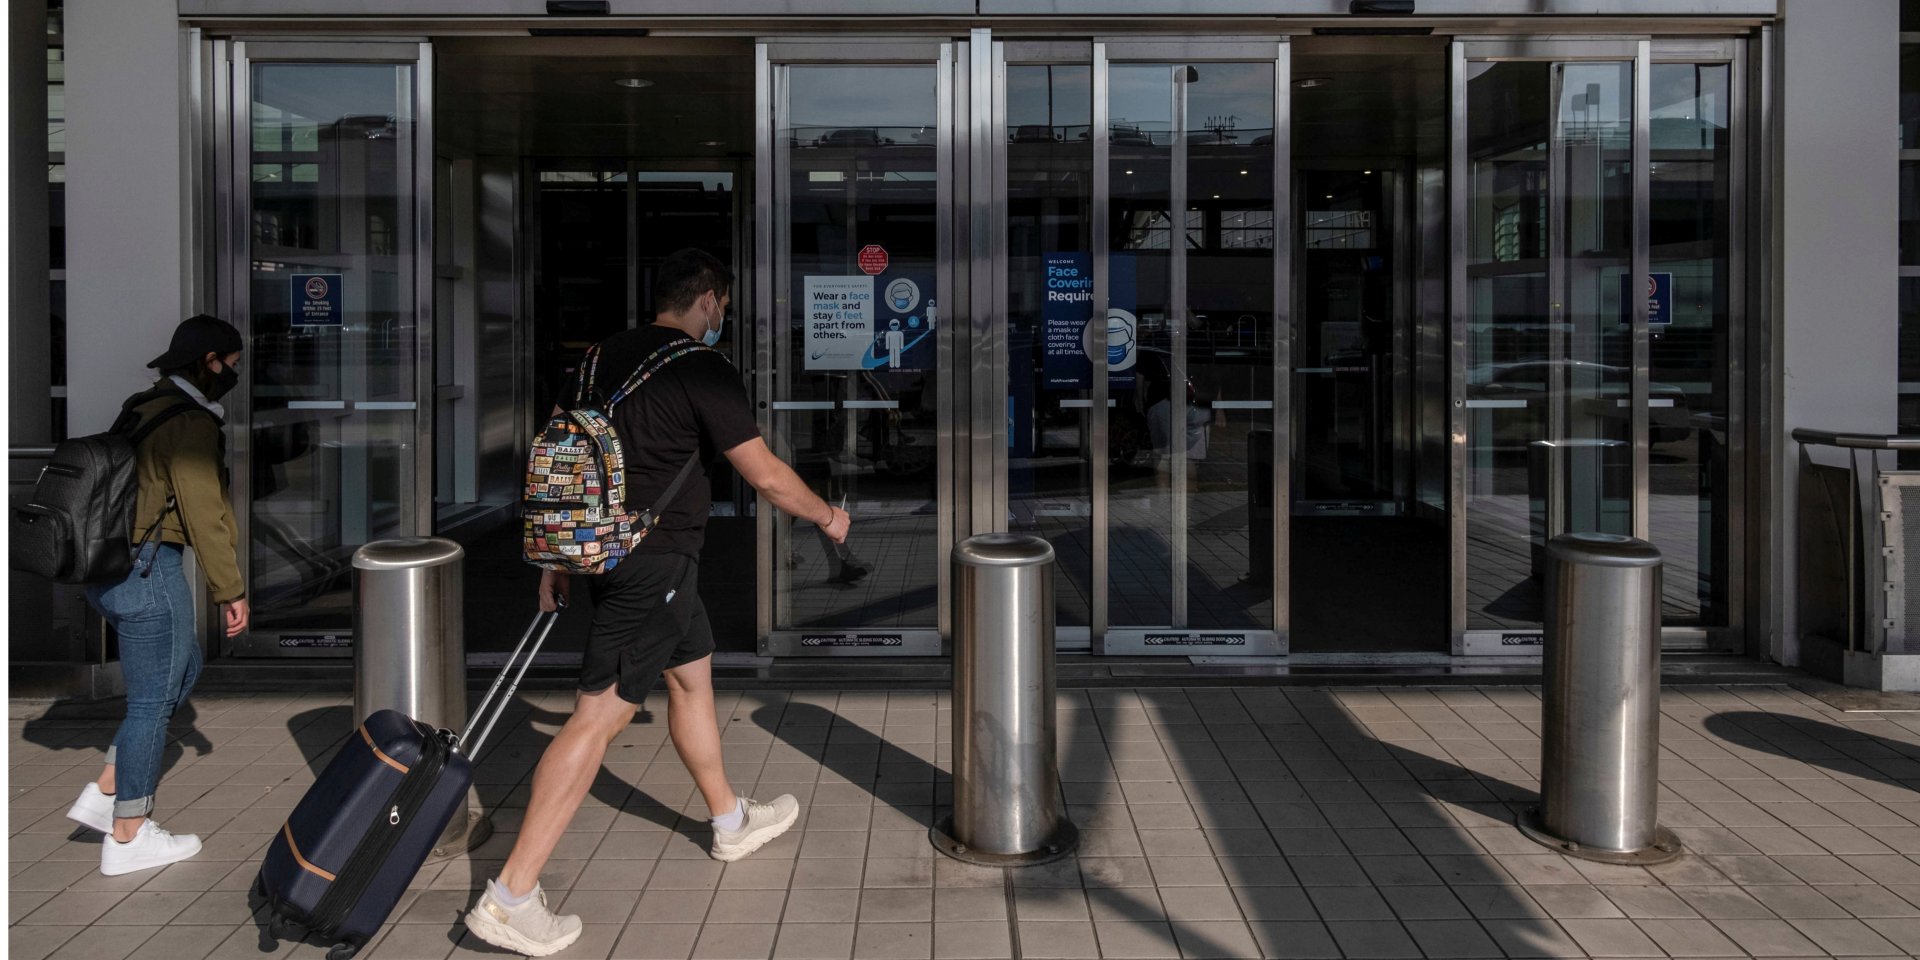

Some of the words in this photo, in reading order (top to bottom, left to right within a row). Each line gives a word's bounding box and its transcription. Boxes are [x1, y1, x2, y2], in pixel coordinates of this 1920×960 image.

[1048, 266, 1078, 277] Face
[1048, 277, 1094, 288] Coverin
[813, 292, 839, 300] Wear
[849, 292, 870, 300] face
[813, 302, 839, 310] mask
[842, 302, 861, 310] and
[813, 312, 833, 321] stay
[835, 311, 842, 320] 6
[843, 311, 863, 320] feet
[813, 322, 839, 331] apart
[841, 321, 865, 329] from
[813, 331, 847, 339] others.
[1047, 341, 1076, 349] covering
[557, 446, 583, 454] BALLY
